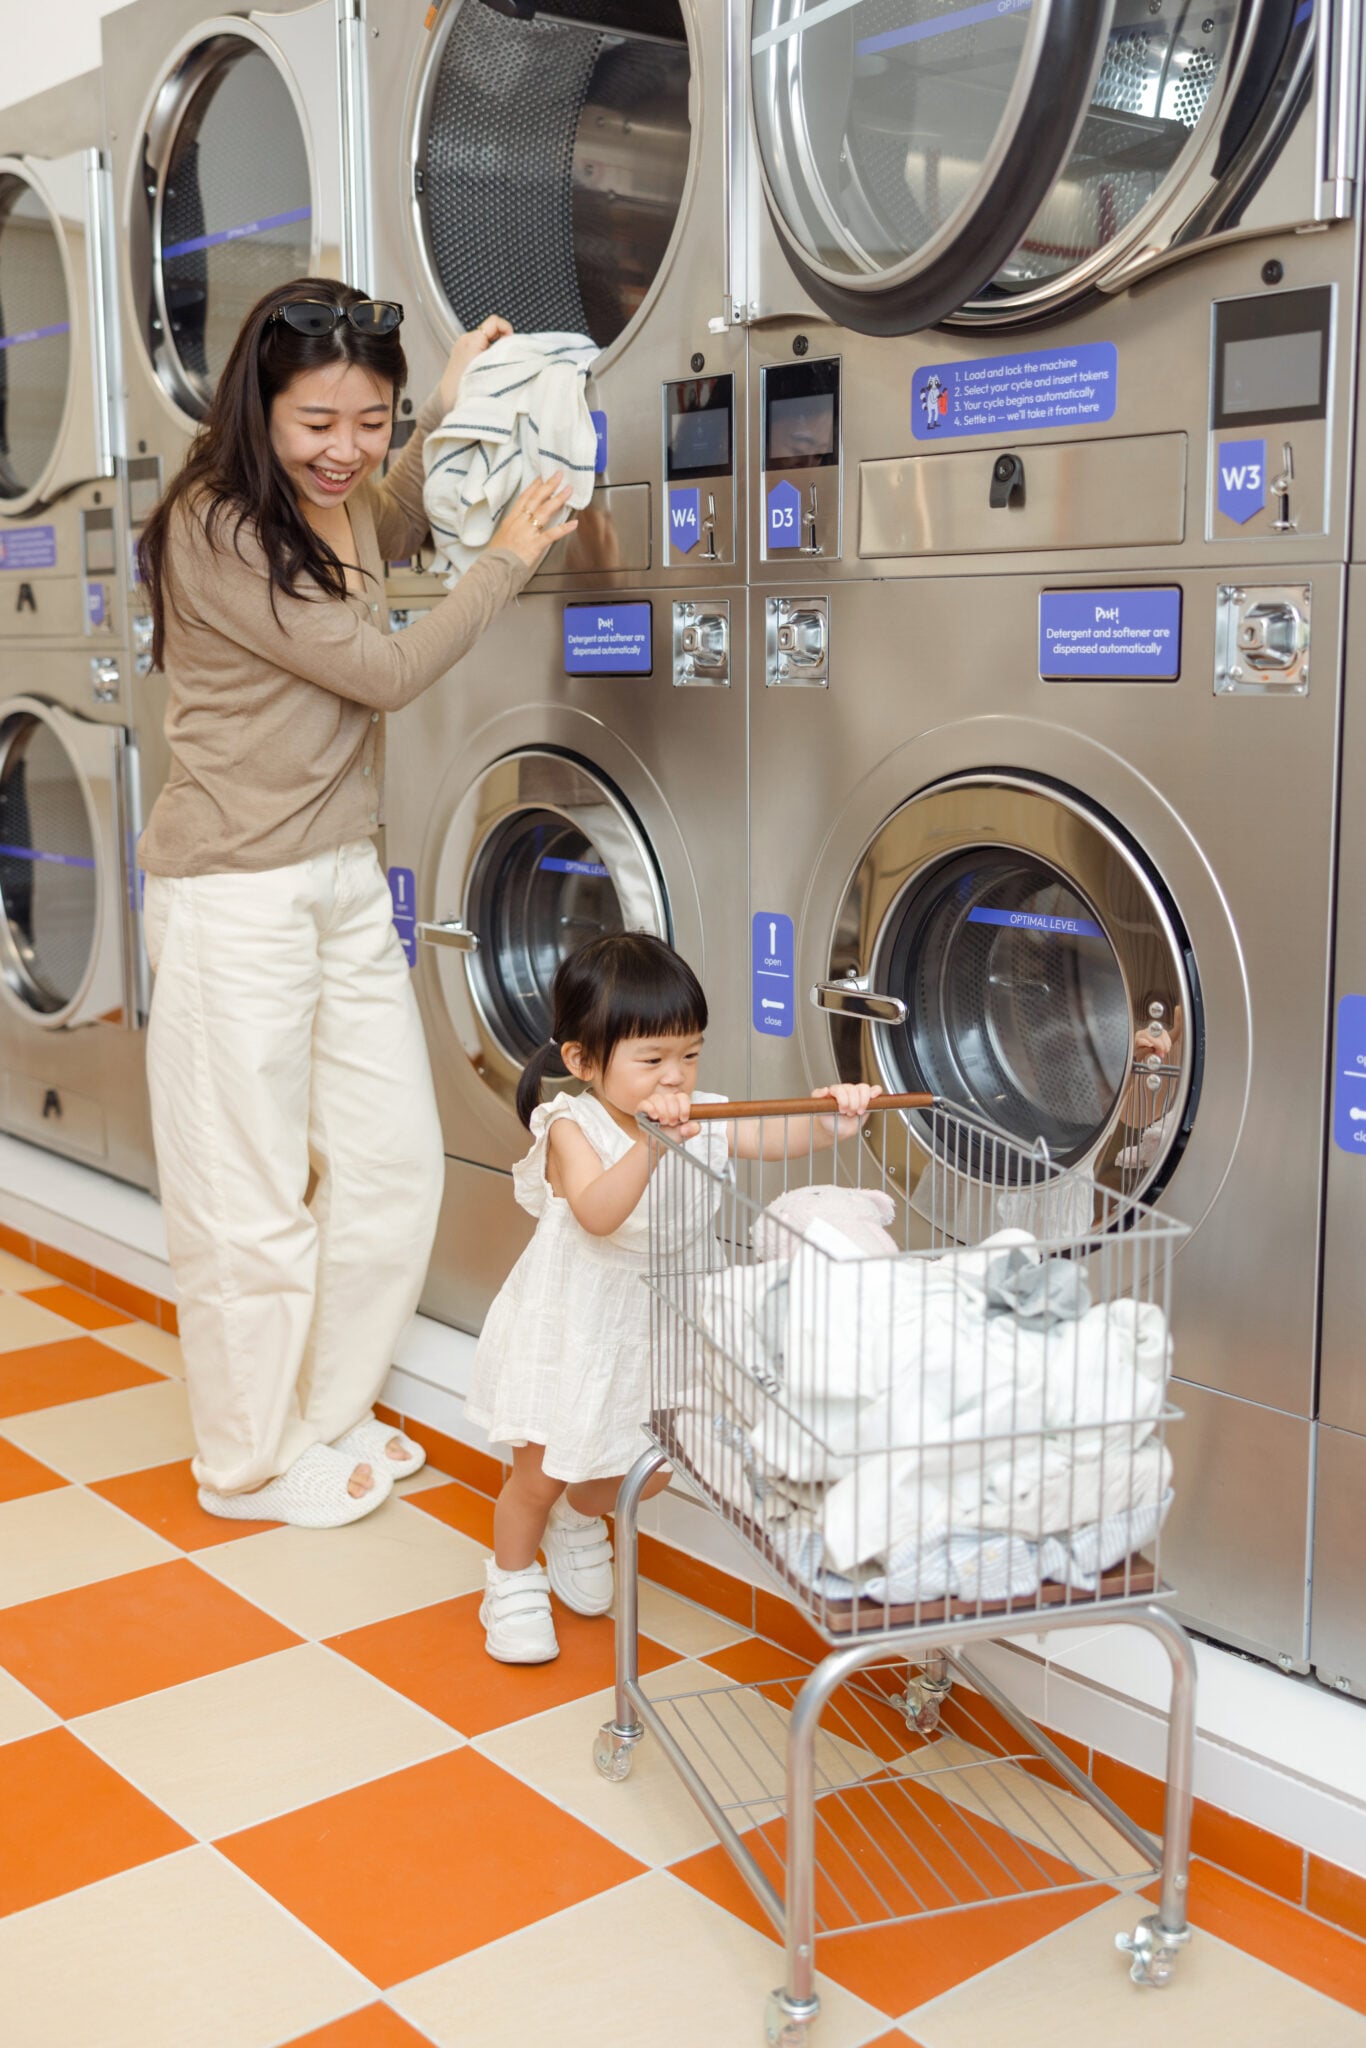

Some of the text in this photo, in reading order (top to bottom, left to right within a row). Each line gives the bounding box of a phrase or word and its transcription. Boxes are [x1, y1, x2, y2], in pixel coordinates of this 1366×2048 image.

[955, 359, 1077, 382] 1. Load and lock the machine
[954, 370, 1109, 397] 2. Select your cycle and insert tokens
[954, 386, 1095, 412] 3. Your cycle begins automatically
[954, 416, 962, 426] 4.
[964, 414, 987, 426] Settle
[988, 413, 996, 423] in
[1007, 409, 1026, 421] we'll
[1027, 408, 1046, 419] take
[1047, 406, 1054, 416] it
[1055, 404, 1077, 416] from
[1078, 402, 1100, 413] here
[1221, 465, 1261, 491] W3
[671, 508, 697, 527] W4
[772, 508, 794, 528] D3
[1046, 626, 1170, 641] Detergent and softener are
[1053, 642, 1162, 656] dispensed automatically
[1010, 914, 1079, 932] OPTIMAL LEVEL
[764, 958, 782, 967] open
[764, 1016, 782, 1026] close
